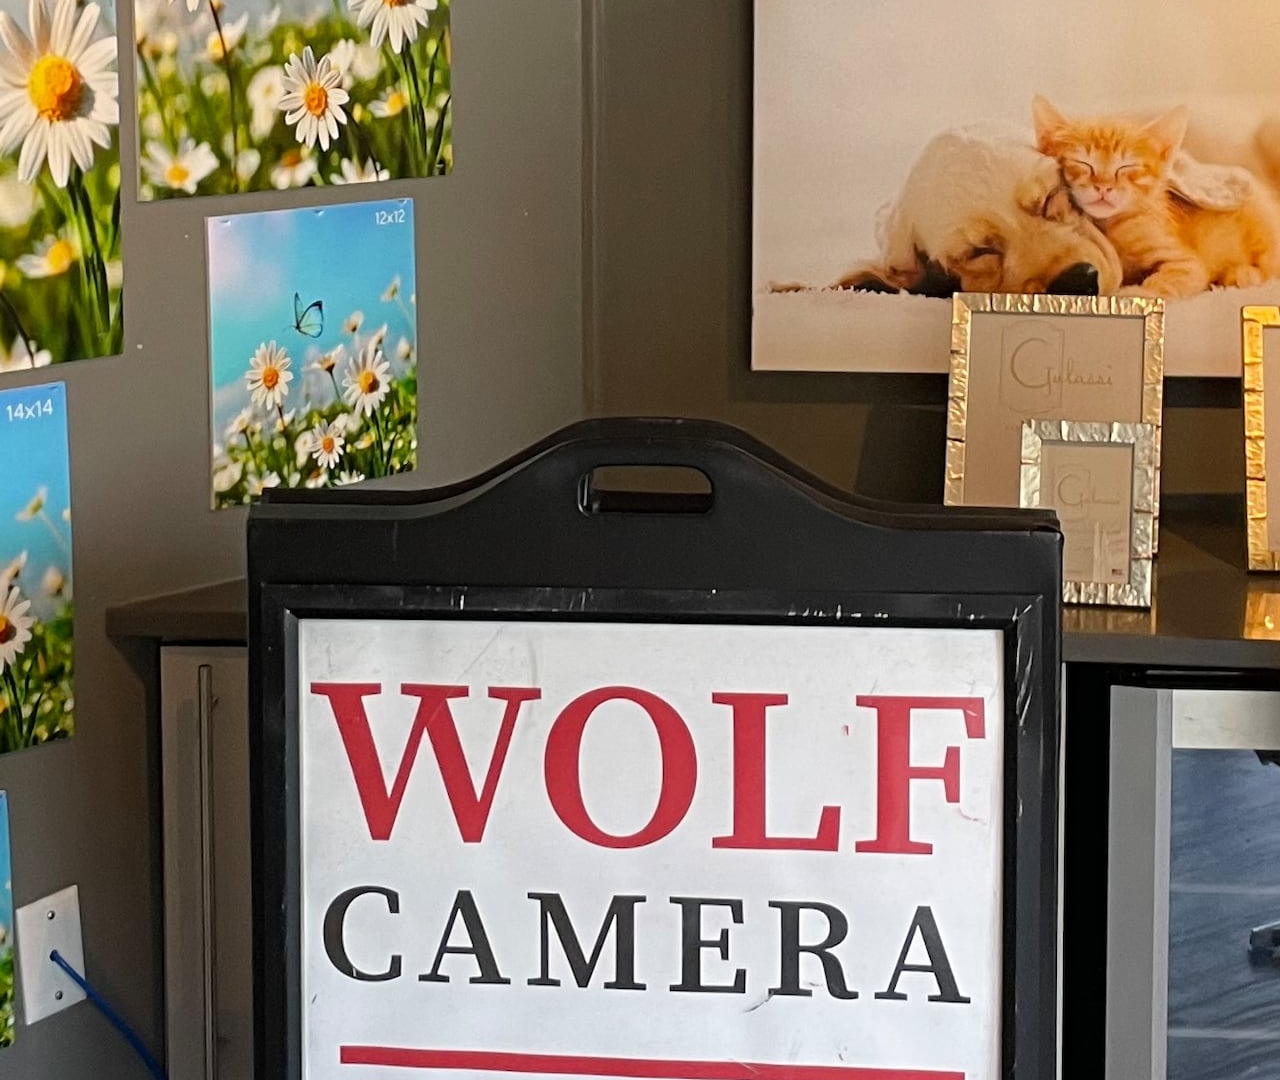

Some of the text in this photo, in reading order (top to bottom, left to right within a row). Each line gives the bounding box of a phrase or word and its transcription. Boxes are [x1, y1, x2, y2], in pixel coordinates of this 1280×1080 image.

[375, 208, 406, 225] 12x12
[6, 399, 53, 422] 14x14
[309, 680, 987, 856] WOLF
[322, 884, 972, 1005] CAMERA
